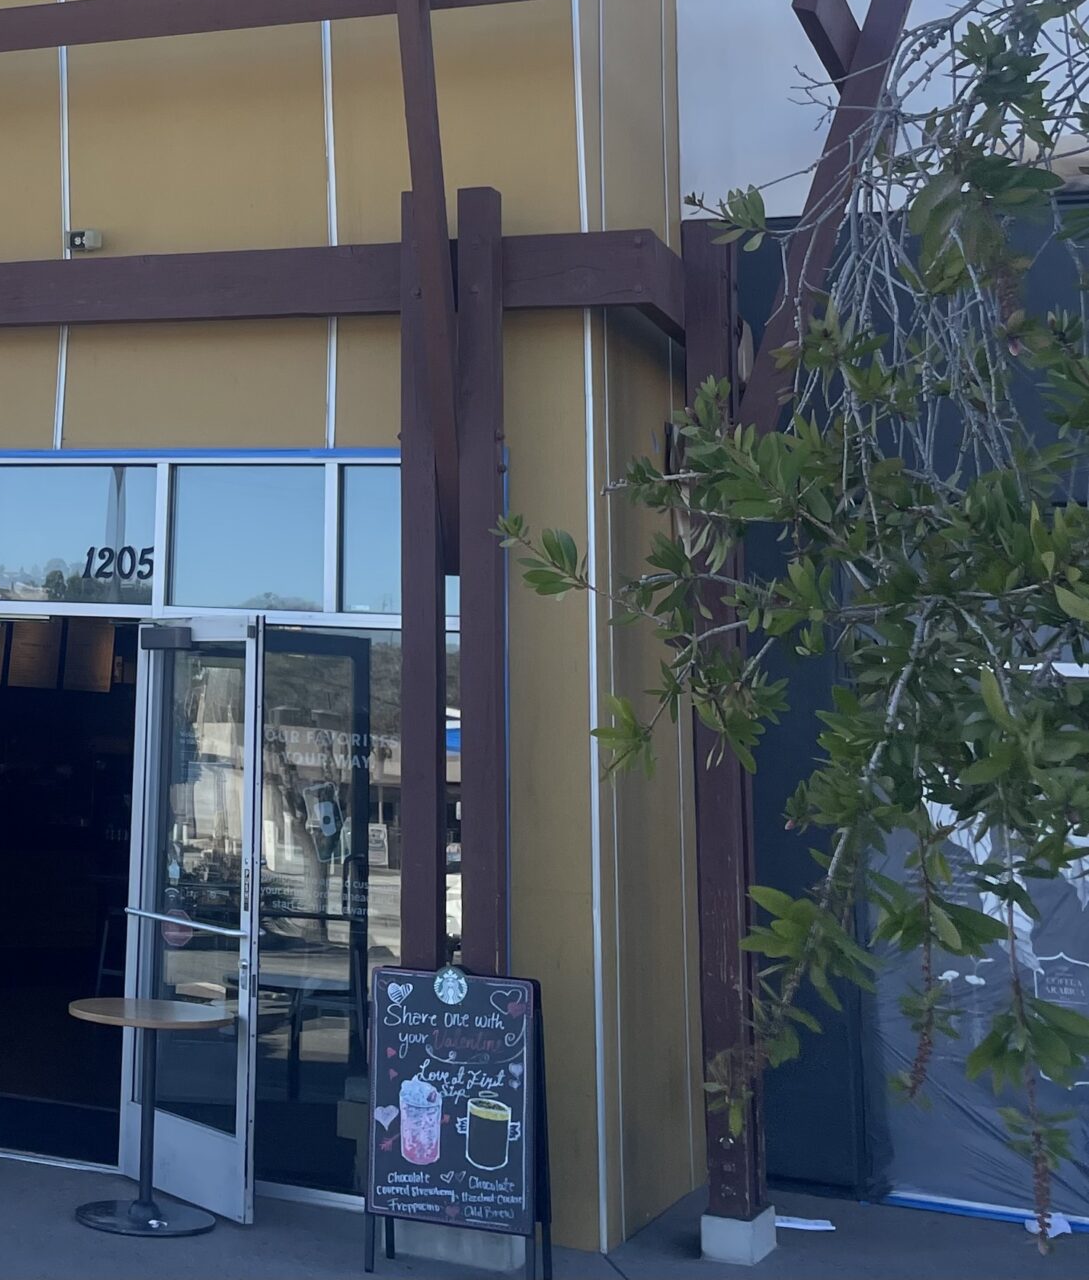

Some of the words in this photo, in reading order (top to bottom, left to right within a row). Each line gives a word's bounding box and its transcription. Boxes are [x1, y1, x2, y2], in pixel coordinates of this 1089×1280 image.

[82, 545, 154, 580] 1205
[264, 729, 300, 743] OUR
[384, 1003, 437, 1026] Share
[444, 1012, 469, 1028] one
[475, 1012, 505, 1030] with
[398, 1032, 428, 1059] your
[417, 1059, 450, 1085] Love
[451, 1066, 465, 1085] at
[466, 1070, 506, 1089] First
[387, 1171, 431, 1184] Chocolate
[468, 1176, 515, 1192] Chocolate
[485, 1206, 515, 1220] Brew
